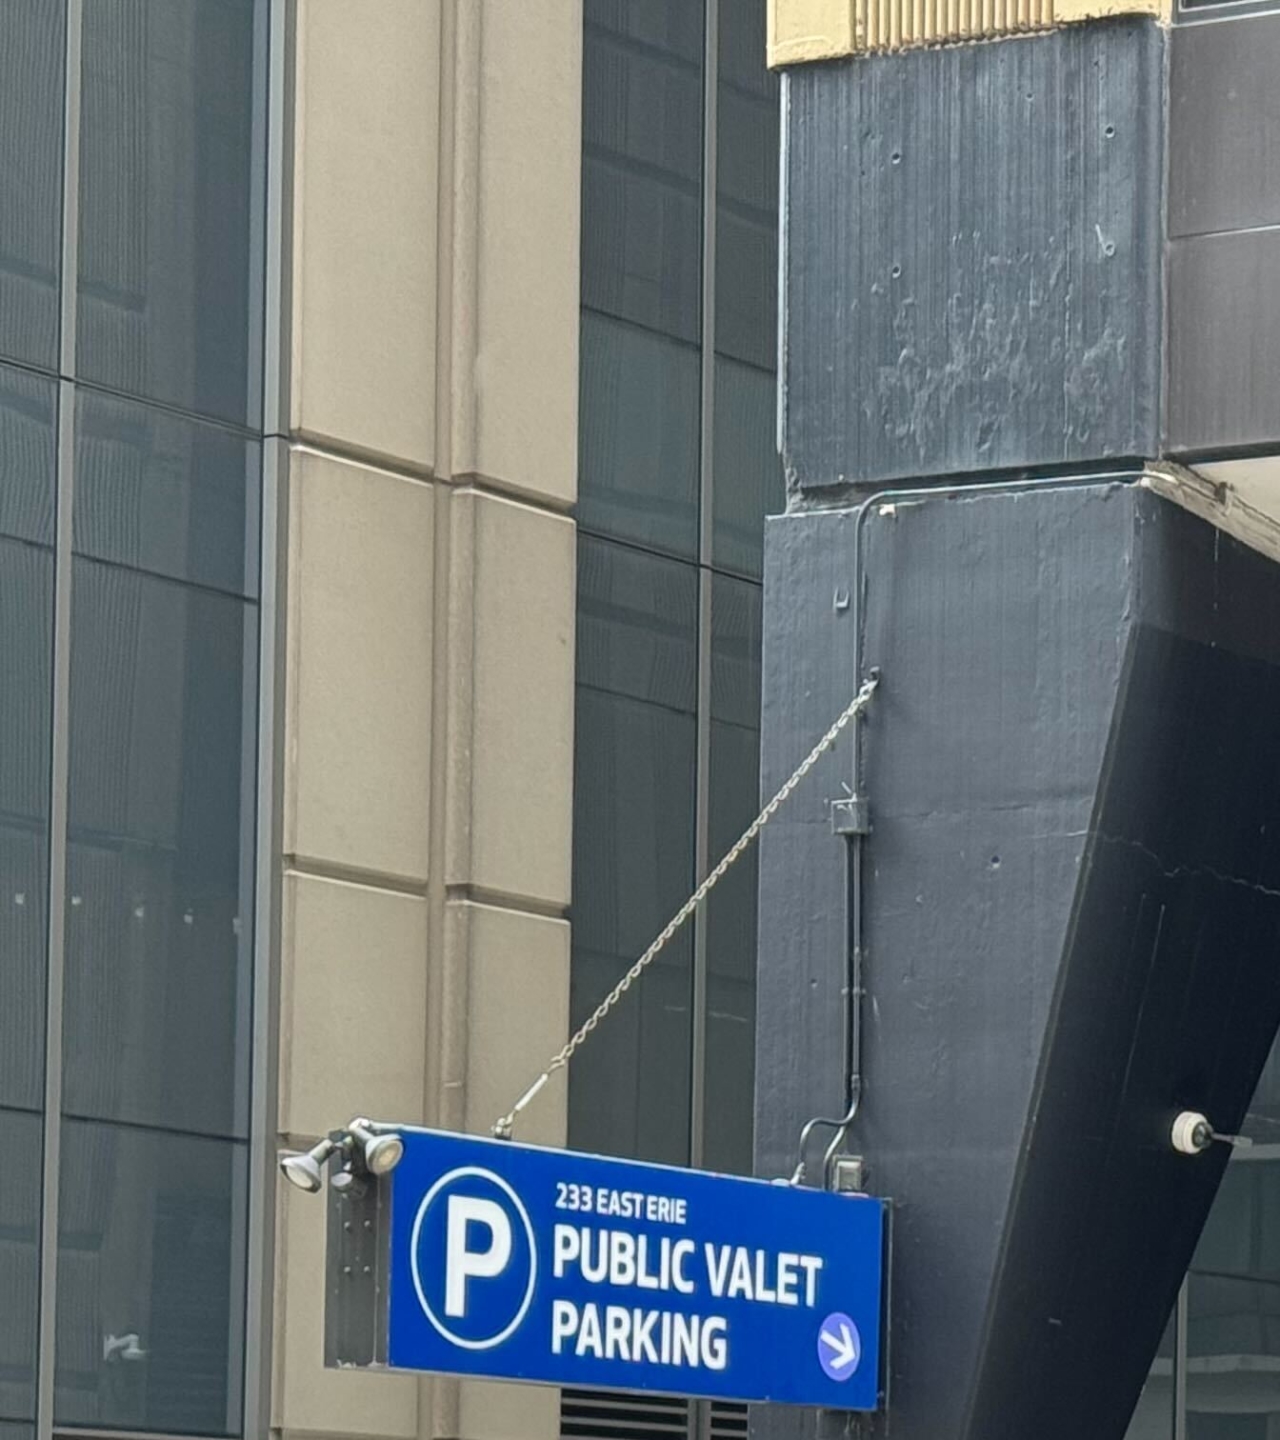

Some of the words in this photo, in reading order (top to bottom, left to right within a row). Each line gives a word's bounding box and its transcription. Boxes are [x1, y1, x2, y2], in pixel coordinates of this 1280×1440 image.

[555, 1182, 593, 1212] 233
[595, 1187, 644, 1219] EAST
[645, 1195, 688, 1225] ERIE
[552, 1223, 695, 1295] PUBLIC
[704, 1242, 823, 1308] VALET
[550, 1299, 728, 1371] PARKING
